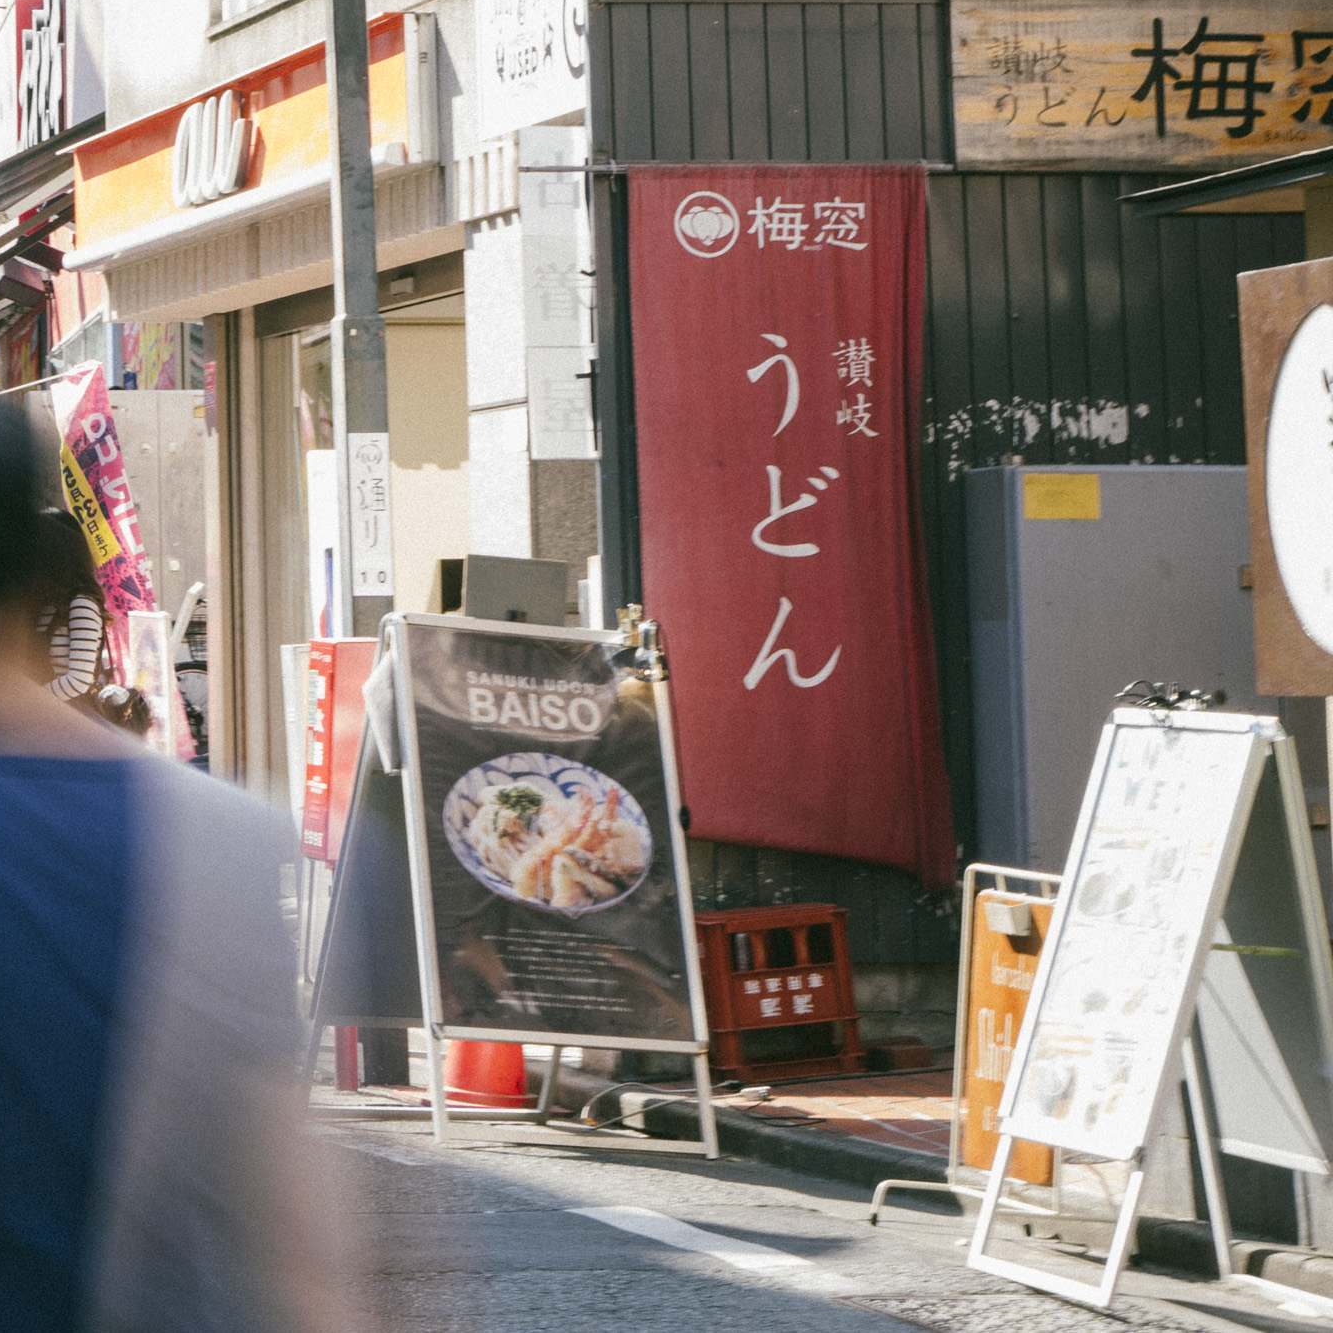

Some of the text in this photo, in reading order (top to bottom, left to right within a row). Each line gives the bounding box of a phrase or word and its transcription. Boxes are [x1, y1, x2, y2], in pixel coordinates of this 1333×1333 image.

[994, 84, 1128, 127] うどん
[744, 333, 842, 690] うどん
[466, 670, 595, 696] SANUKI UDON
[467, 686, 603, 733] BAISO
